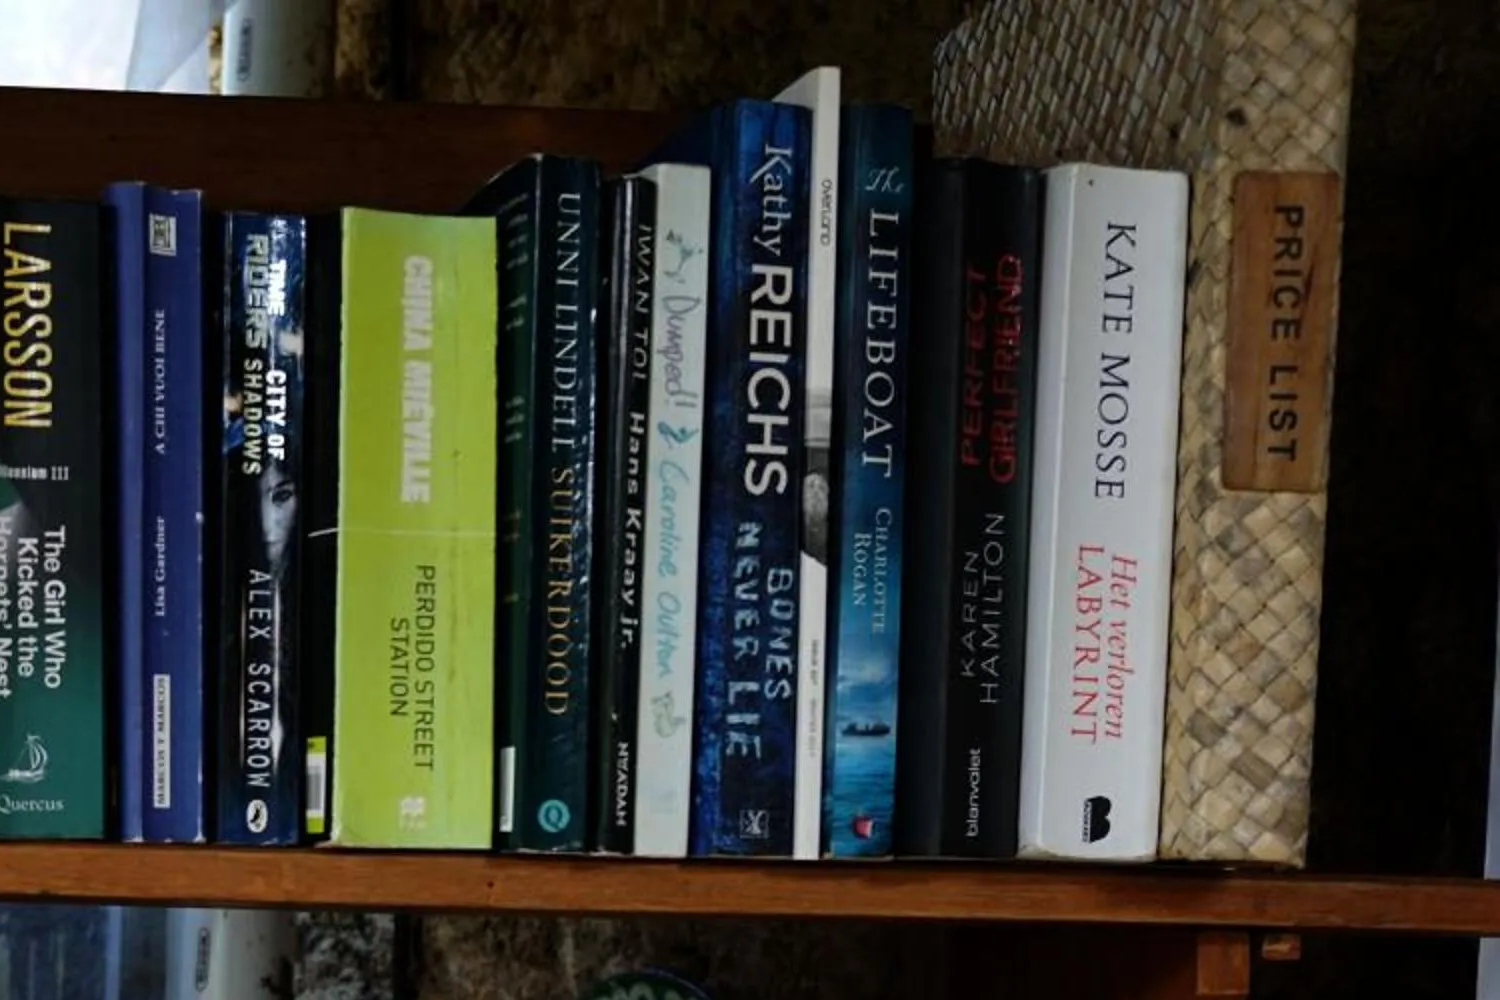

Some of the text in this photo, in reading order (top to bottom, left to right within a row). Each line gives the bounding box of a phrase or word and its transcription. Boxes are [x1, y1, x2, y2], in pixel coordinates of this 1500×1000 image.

[3, 221, 53, 428] LARSSON
[242, 233, 270, 351] RIDERS
[267, 259, 287, 317] TIME
[403, 255, 433, 350] CHINA
[551, 192, 581, 452] UNNI LINDELL
[635, 225, 653, 314] IWAN
[743, 143, 793, 495] Kathy REICHS
[861, 208, 900, 479] LIFEBOAT
[1267, 205, 1304, 462] PRICE LIST
[154, 308, 167, 455] A CHI VUOI BENE
[242, 359, 265, 476] SHADOWS
[264, 369, 288, 461] CITY OF
[655, 296, 700, 409] Dumped!
[962, 265, 988, 467] PERFECT
[988, 253, 1025, 485] GIRLFRIEND
[1094, 221, 1138, 499] KATE MOSSE
[51, 466, 69, 481] III
[619, 412, 645, 649] Hans Kraay jr.
[16, 537, 39, 678] Kicked the
[43, 525, 66, 689] The Girl Who
[154, 515, 167, 617] Lisa Gardner
[545, 465, 576, 716] SUIKERDOOD
[725, 521, 764, 761] NEVER LIE
[764, 567, 794, 700] BONES
[852, 531, 872, 607] ROGAN
[872, 507, 892, 635] CHARLOTTE
[960, 550, 980, 678] KAREN
[980, 512, 1005, 704] HAMILTON
[247, 569, 272, 788] ALEX SCARROW
[390, 617, 411, 718] STATION
[414, 564, 436, 771] PERDIDO STREET
[1070, 543, 1106, 746] LABYRINT
[1104, 554, 1138, 740] Het verloren
[965, 747, 981, 838] blanvalet
